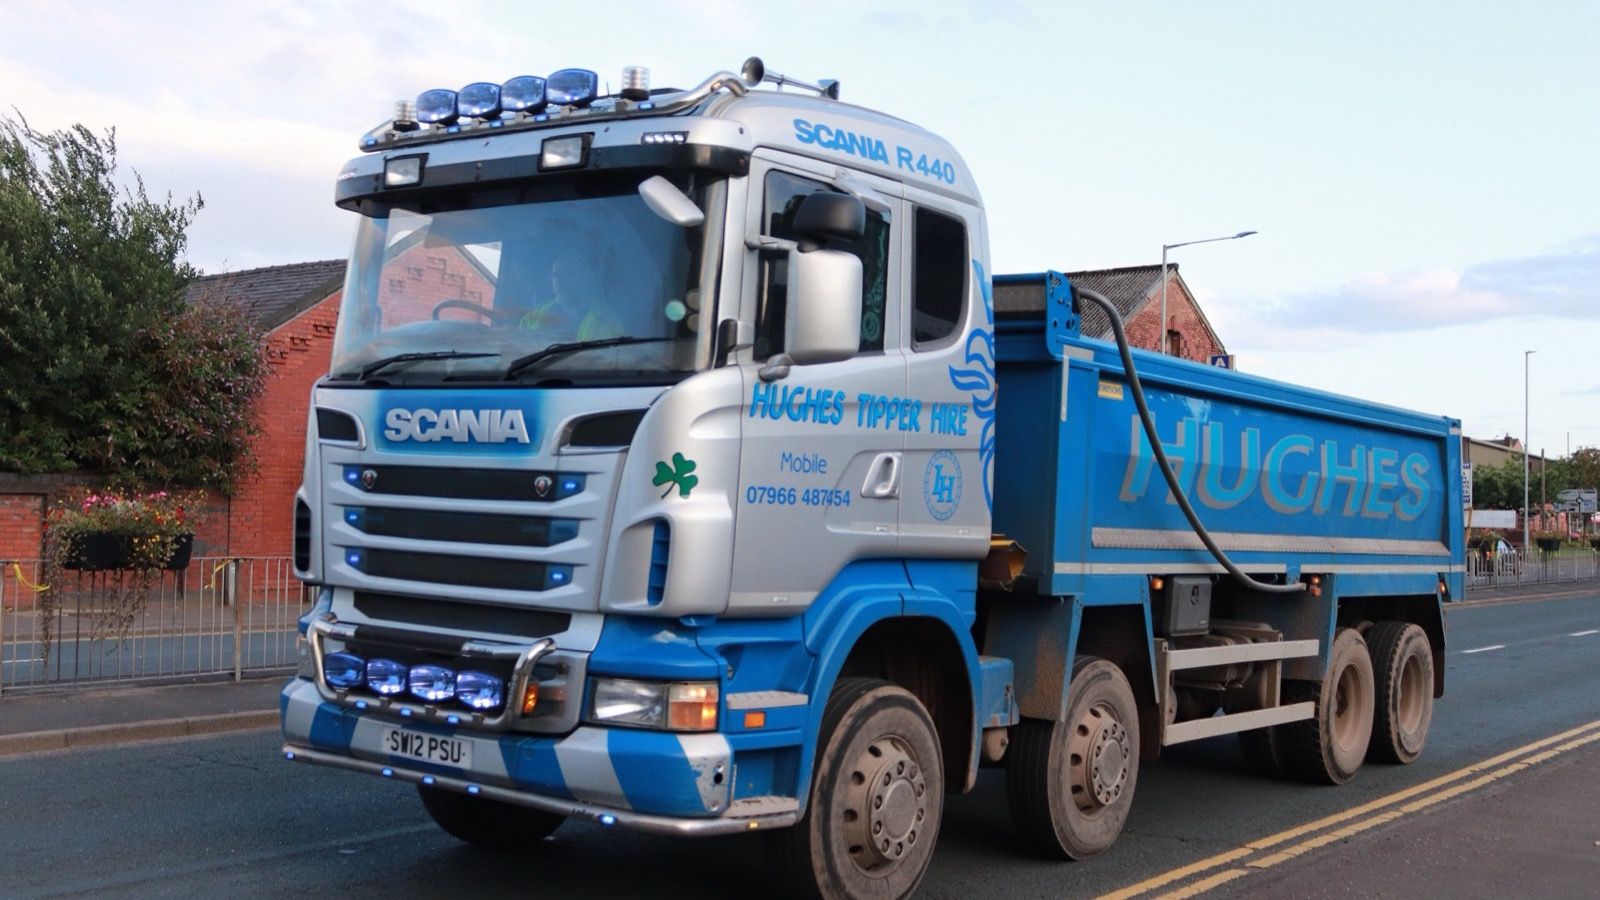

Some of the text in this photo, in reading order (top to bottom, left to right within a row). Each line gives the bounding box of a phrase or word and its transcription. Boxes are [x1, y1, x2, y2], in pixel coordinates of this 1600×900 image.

[793, 118, 956, 185] SCANIA R440
[383, 408, 530, 444] SCANIA
[749, 382, 969, 436] HUGHES TIPPER HIRE
[780, 451, 828, 474] Mobile
[1119, 412, 1431, 522] HUGHES
[746, 486, 851, 507] 07966 487454
[390, 730, 462, 764] SW12 PSU
